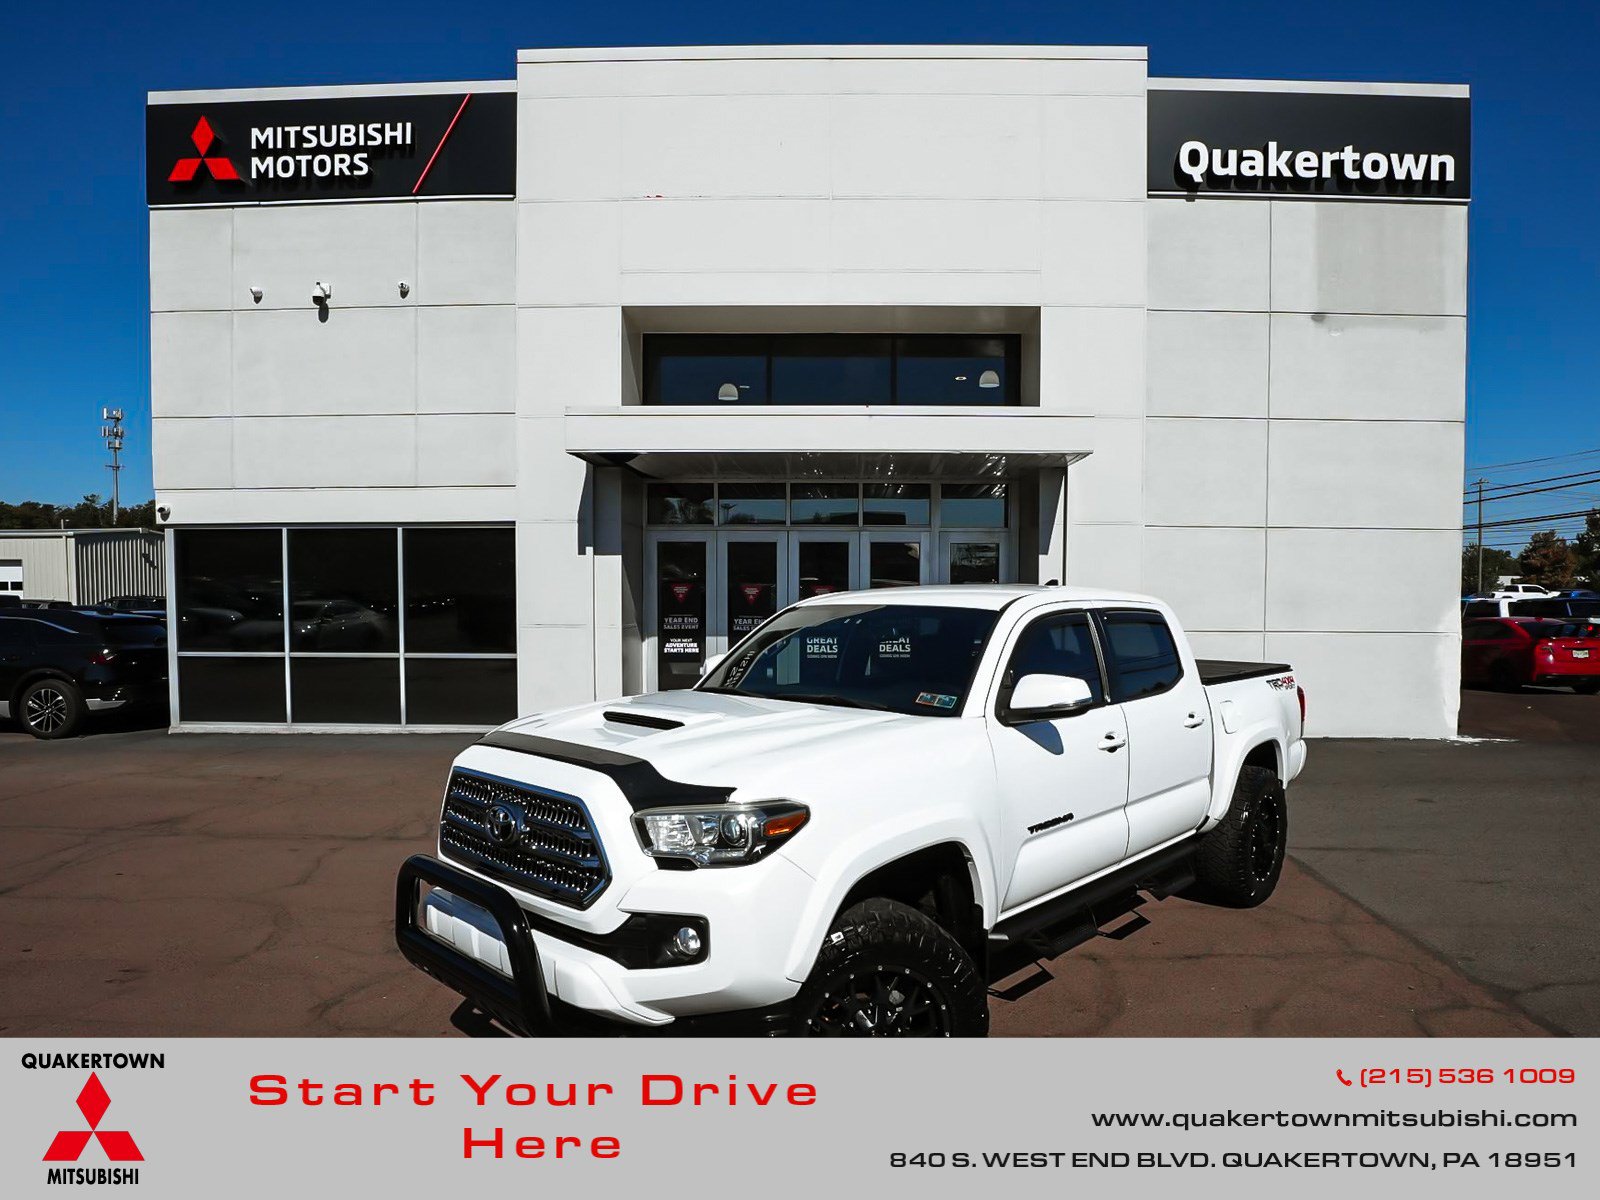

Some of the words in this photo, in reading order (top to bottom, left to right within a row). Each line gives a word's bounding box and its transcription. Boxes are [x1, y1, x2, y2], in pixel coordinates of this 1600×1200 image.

[251, 122, 412, 150] MITSUBISHI
[251, 153, 370, 179] MOTORS
[1179, 140, 1455, 182] Quakertown
[806, 644, 838, 653] DEALS
[879, 644, 911, 652] DEALS
